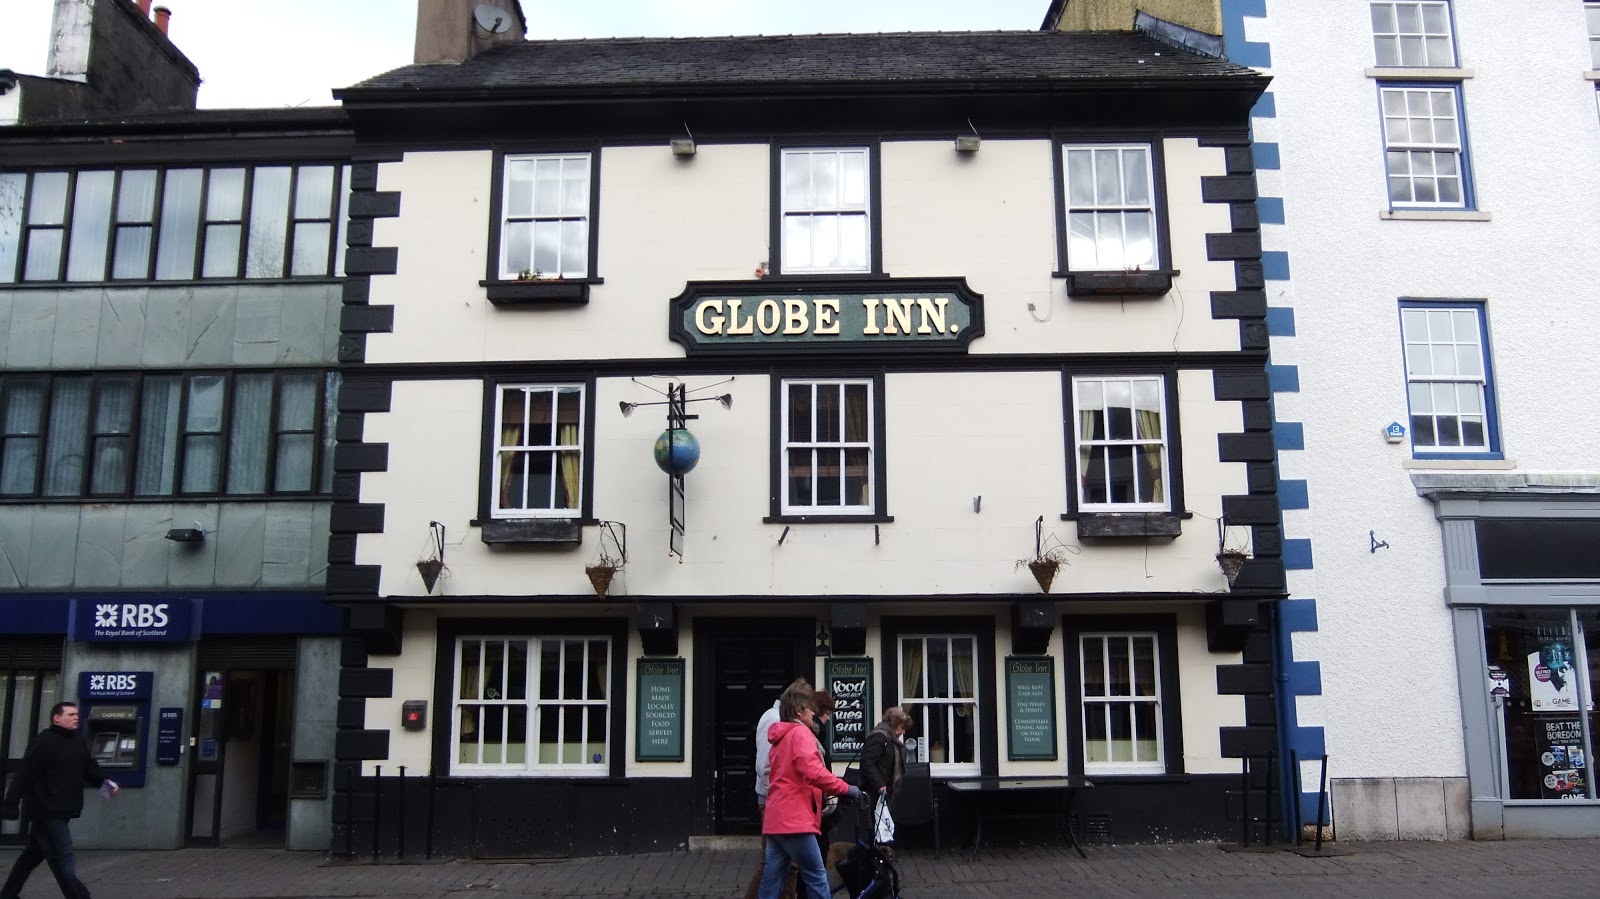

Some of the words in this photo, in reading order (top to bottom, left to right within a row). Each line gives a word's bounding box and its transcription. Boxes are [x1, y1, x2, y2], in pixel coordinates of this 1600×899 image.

[695, 298, 840, 335] GLOBE
[863, 298, 959, 334] INN.
[121, 604, 169, 628] RBS
[644, 664, 664, 674] Globe
[666, 664, 679, 674] Inn
[832, 663, 852, 674] Globe
[854, 664, 867, 674] Inn
[1013, 662, 1032, 673] Globe
[1035, 662, 1047, 673] Inn
[106, 675, 136, 690] RBS
[1552, 697, 1572, 705] GAME
[645, 711, 676, 719] SOURCED
[1545, 722, 1564, 732] BEAT
[1566, 721, 1581, 730] THE
